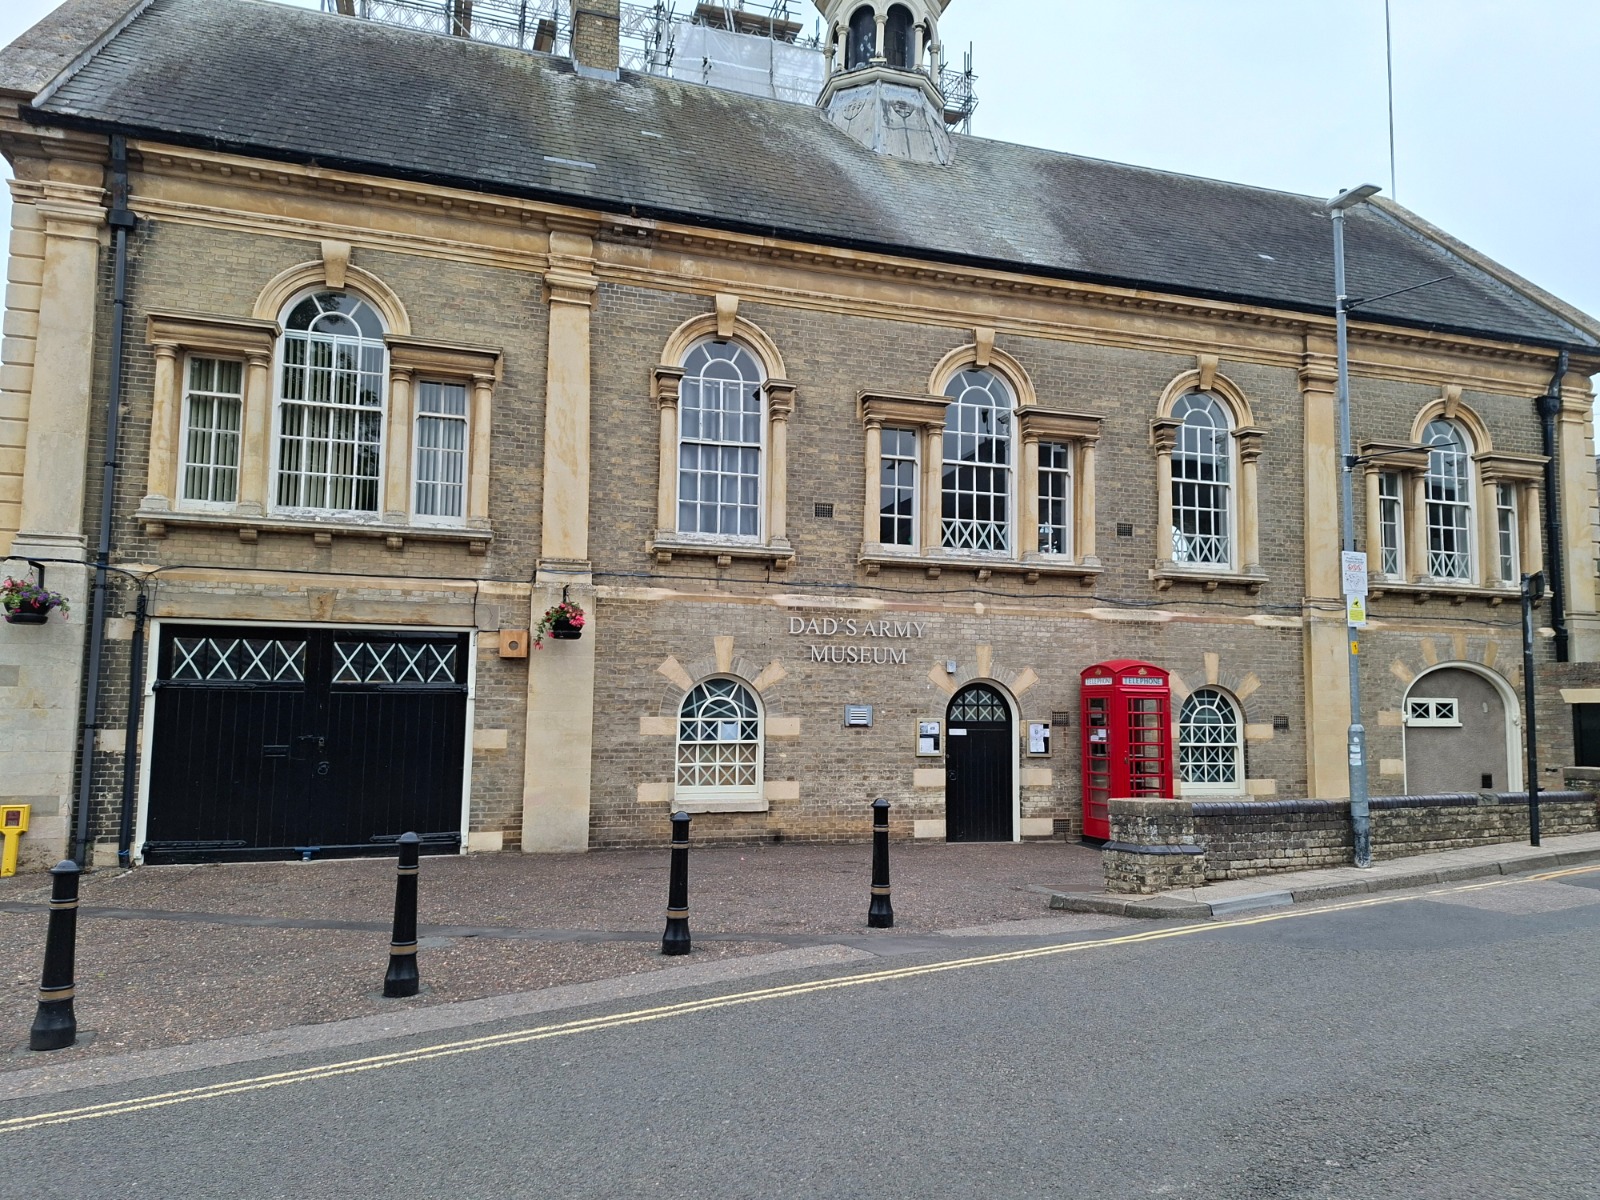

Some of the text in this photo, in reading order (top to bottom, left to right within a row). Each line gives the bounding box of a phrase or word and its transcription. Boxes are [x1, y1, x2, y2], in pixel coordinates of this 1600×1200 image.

[788, 616, 926, 638] DAD'S ARMY
[810, 644, 908, 665] MUSEUM
[1124, 677, 1161, 685] TELEPHONE
